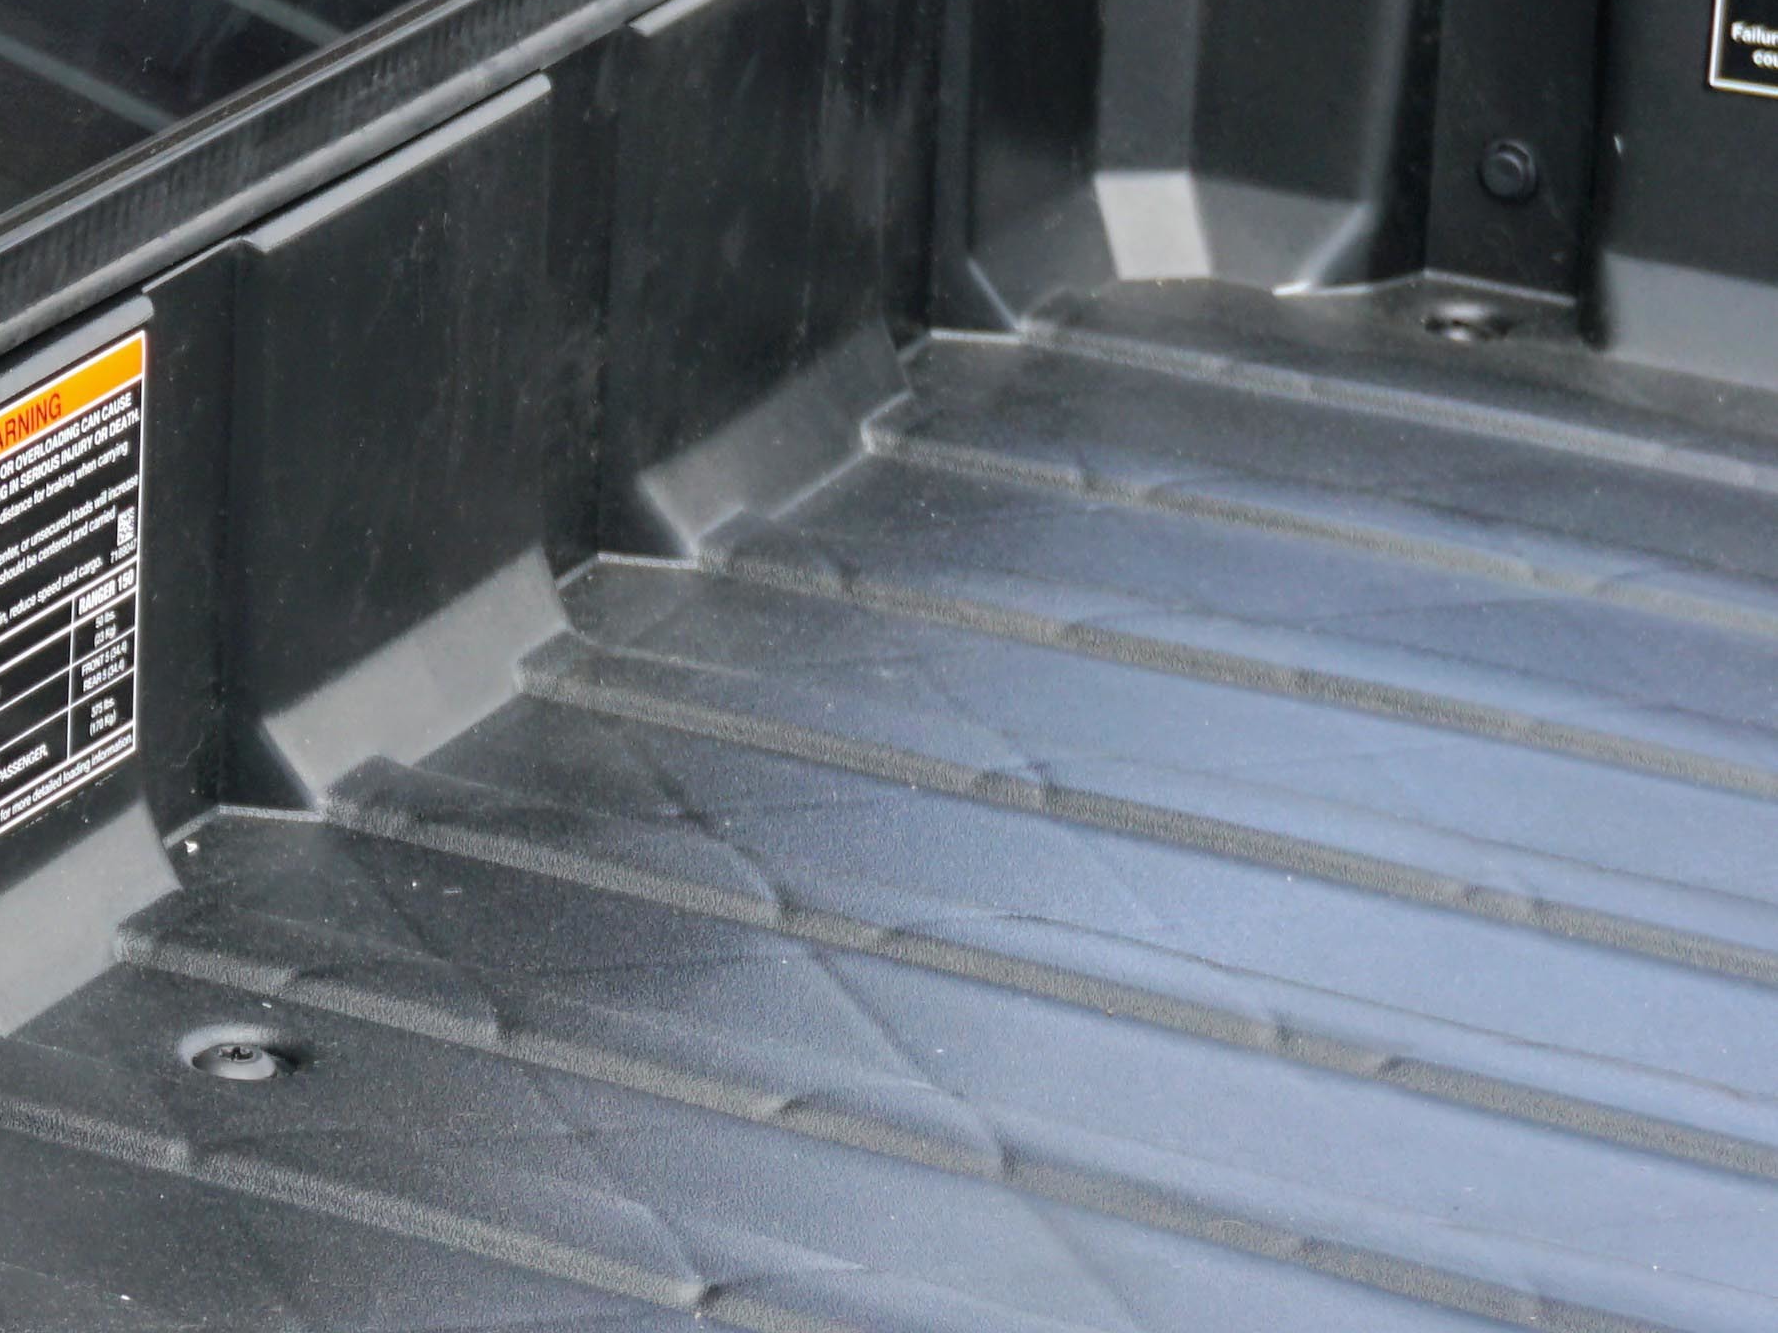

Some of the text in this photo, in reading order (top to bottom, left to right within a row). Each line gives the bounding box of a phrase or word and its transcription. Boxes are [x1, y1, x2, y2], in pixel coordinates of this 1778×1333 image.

[0, 459, 14, 479] OR
[15, 422, 80, 470] OVERLOADING
[80, 410, 100, 432] CAN
[101, 392, 132, 420] CAUSE
[8, 477, 18, 494] IN
[19, 453, 60, 488] SERIOUS
[60, 434, 93, 464] INJURY
[93, 426, 108, 445] OR
[108, 407, 140, 436] DEATH.
[0, 494, 32, 523] distance
[32, 486, 45, 504] for
[45, 469, 75, 500] braking
[75, 456, 97, 479] when
[97, 439, 128, 470] carrying
[20, 538, 30, 551] or
[30, 512, 71, 546] unsecured
[71, 499, 93, 521] loads
[93, 490, 107, 508] will
[107, 473, 138, 500] increase
[25, 552, 37, 568] be
[37, 531, 72, 562] centered
[72, 522, 88, 541] and
[88, 505, 116, 531] carried
[8, 592, 36, 618] reduce
[36, 577, 61, 605] speed
[62, 568, 78, 587] and
[78, 555, 103, 581] cargo.
[78, 568, 134, 615] RANGER 150
[80, 654, 104, 677] FRONT
[82, 670, 102, 691] REAR
[0, 805, 11, 821] for
[11, 795, 32, 814] more
[32, 773, 62, 802] detailed
[62, 756, 90, 787] loading
[91, 729, 133, 765] information.
